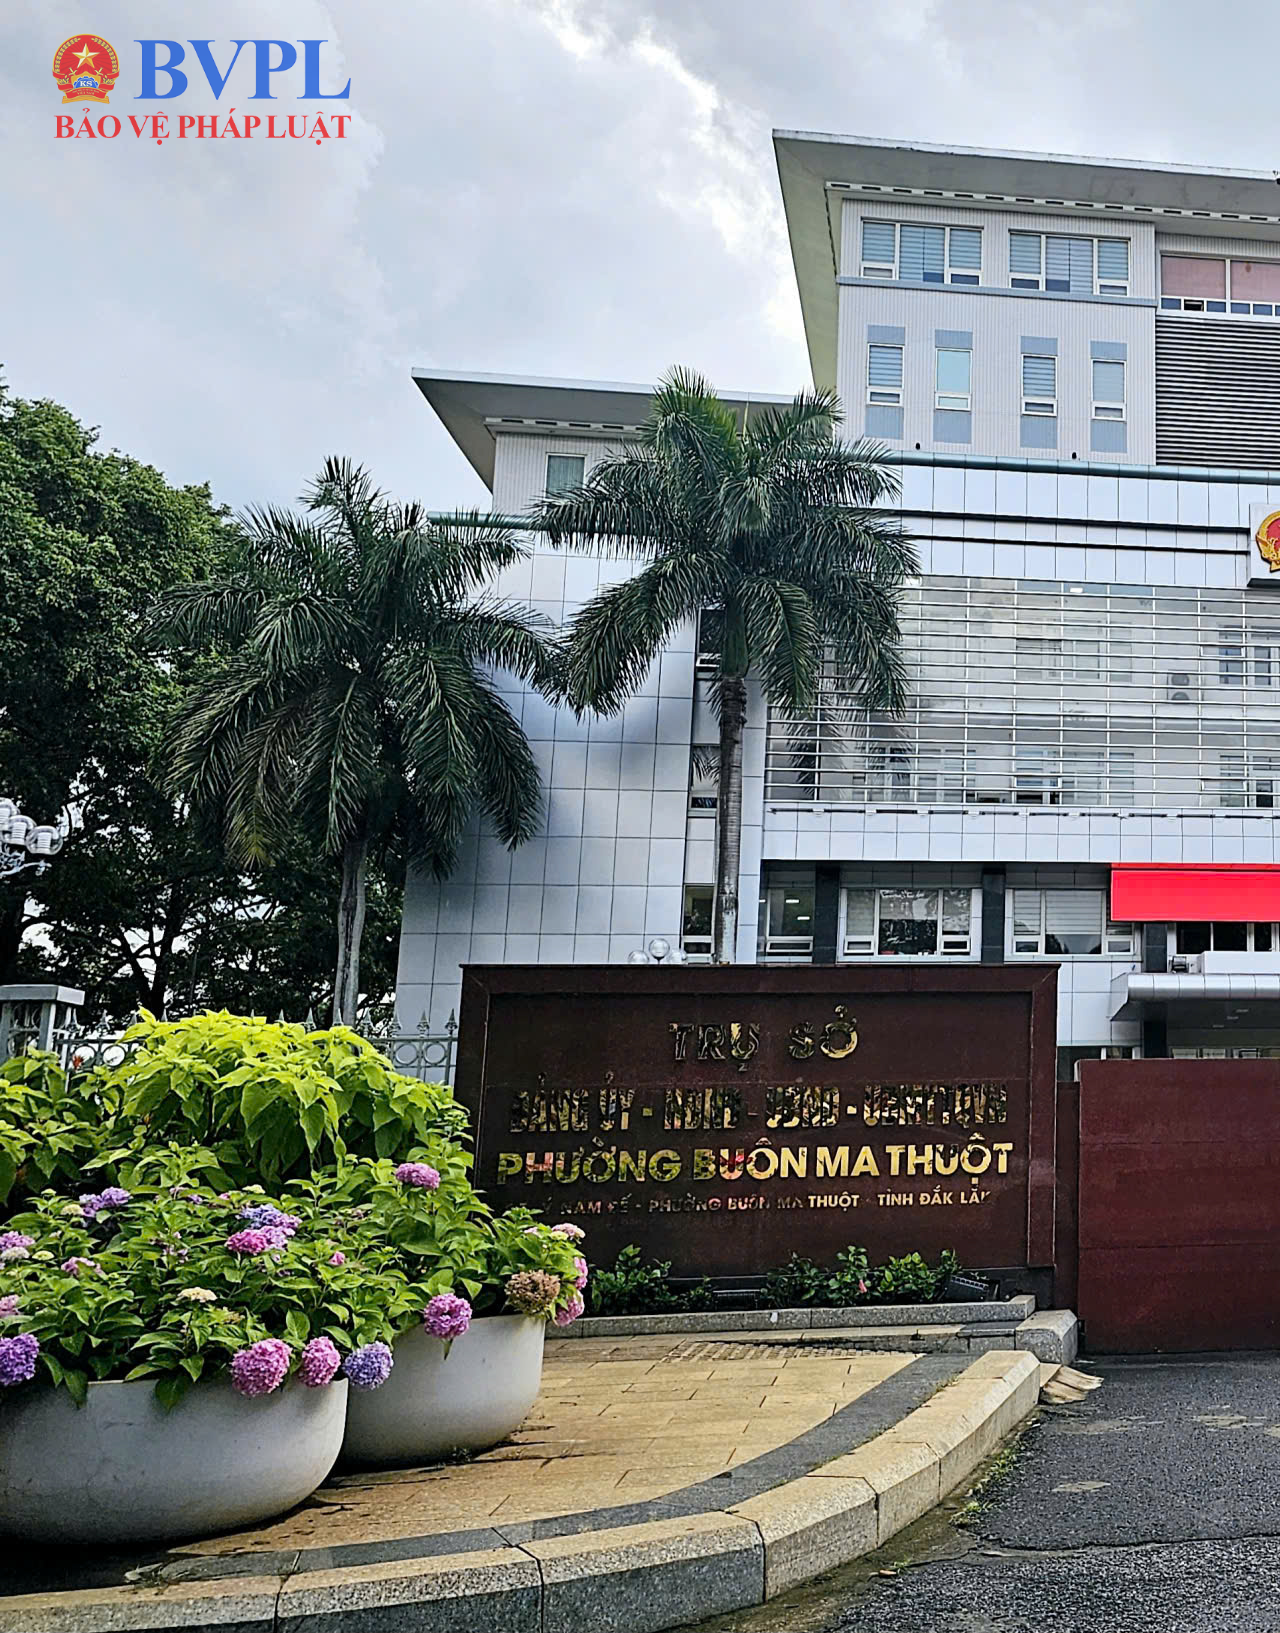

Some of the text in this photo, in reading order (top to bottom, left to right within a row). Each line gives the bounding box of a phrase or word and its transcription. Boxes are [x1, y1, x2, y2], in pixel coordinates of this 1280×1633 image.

[668, 1004, 859, 1072] TRỤ SỞ
[599, 1071, 636, 1132] ỦY
[496, 1131, 1014, 1185] PHƯỜNG BUÔN MA THUỘT
[808, 1190, 860, 1212] THUỘT
[919, 1184, 954, 1206] ĐẮK
